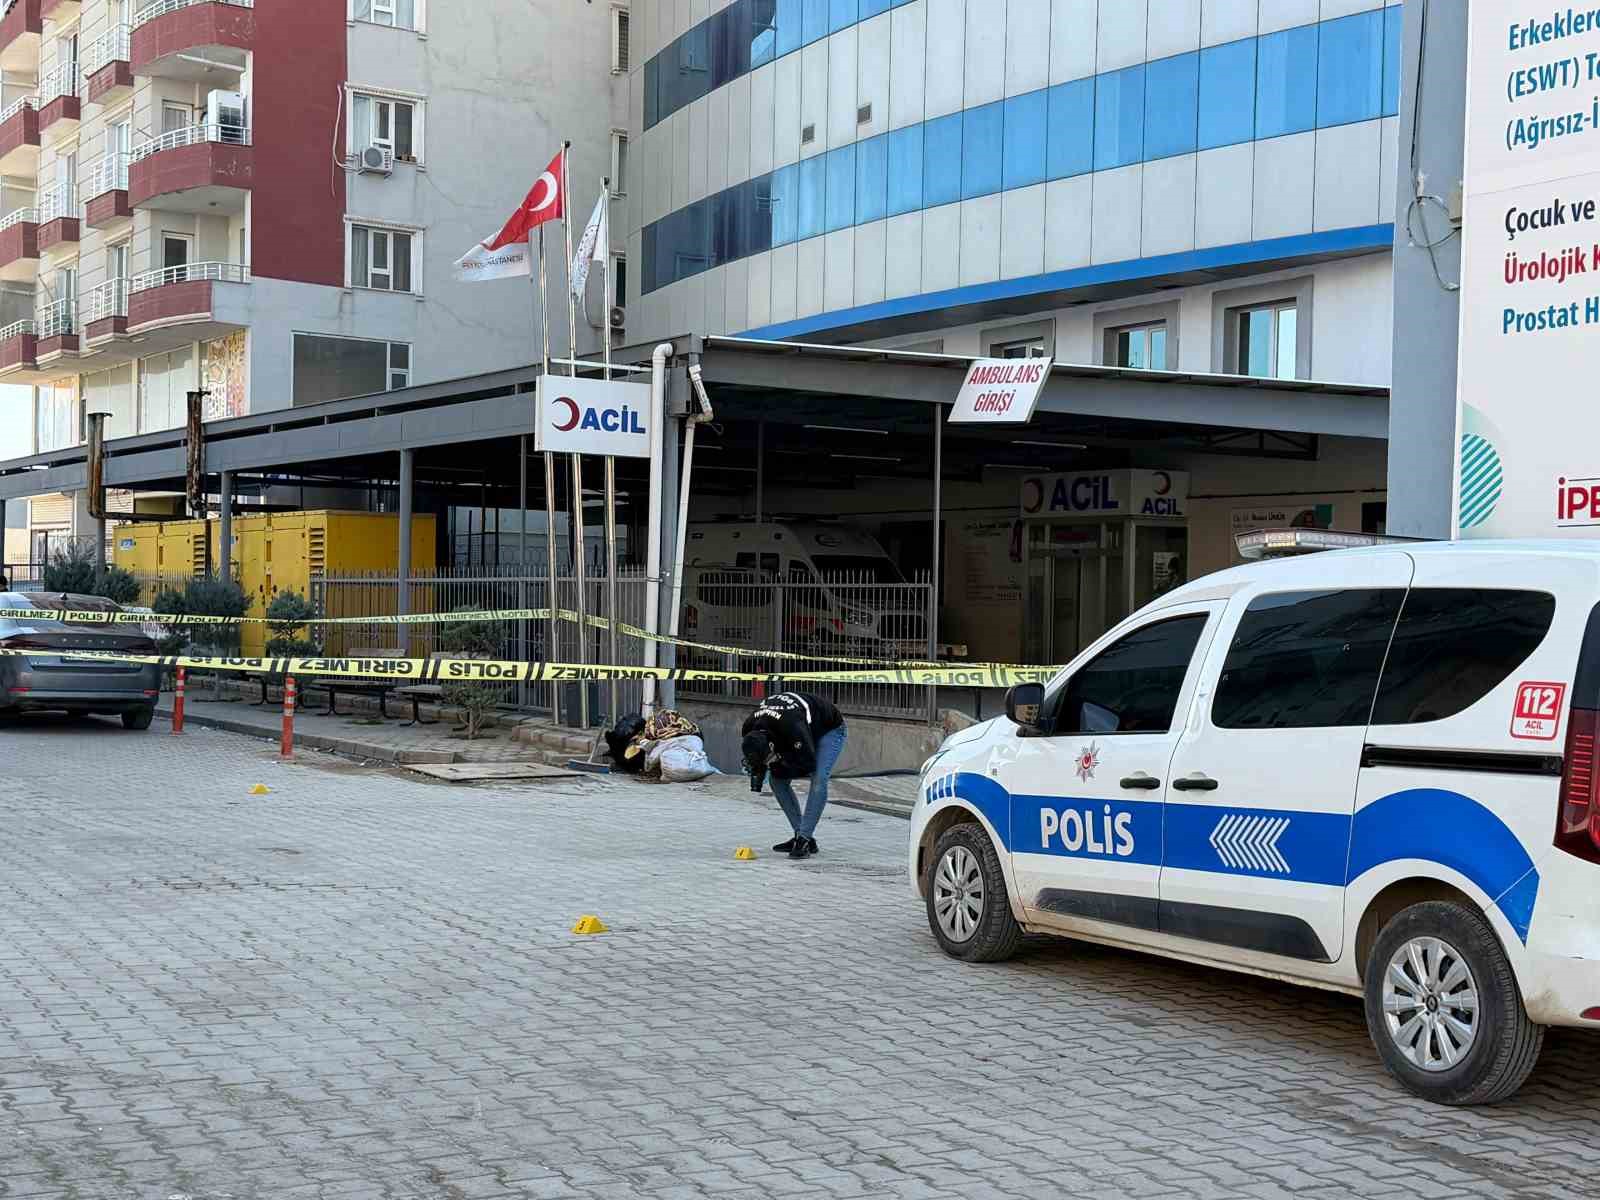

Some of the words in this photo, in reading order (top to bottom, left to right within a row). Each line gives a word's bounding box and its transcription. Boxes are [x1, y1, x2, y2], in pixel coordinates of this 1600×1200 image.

[1507, 57, 1579, 103] (ESWT)
[1585, 53, 1600, 80] T
[1505, 199, 1566, 240] Çocuk
[1571, 200, 1595, 222] ve
[1504, 247, 1586, 284] Ürolojik
[1503, 302, 1579, 334] Prostat
[968, 364, 1043, 385] AMBULANS
[974, 389, 1017, 416] GİRİŞİ
[581, 404, 646, 434] ACİL
[1050, 475, 1120, 511] ACİL
[298, 658, 413, 674] GİRİLMEZ
[449, 662, 518, 678] POLİS
[1522, 688, 1557, 715] 112
[1040, 804, 1135, 856] POLİS
